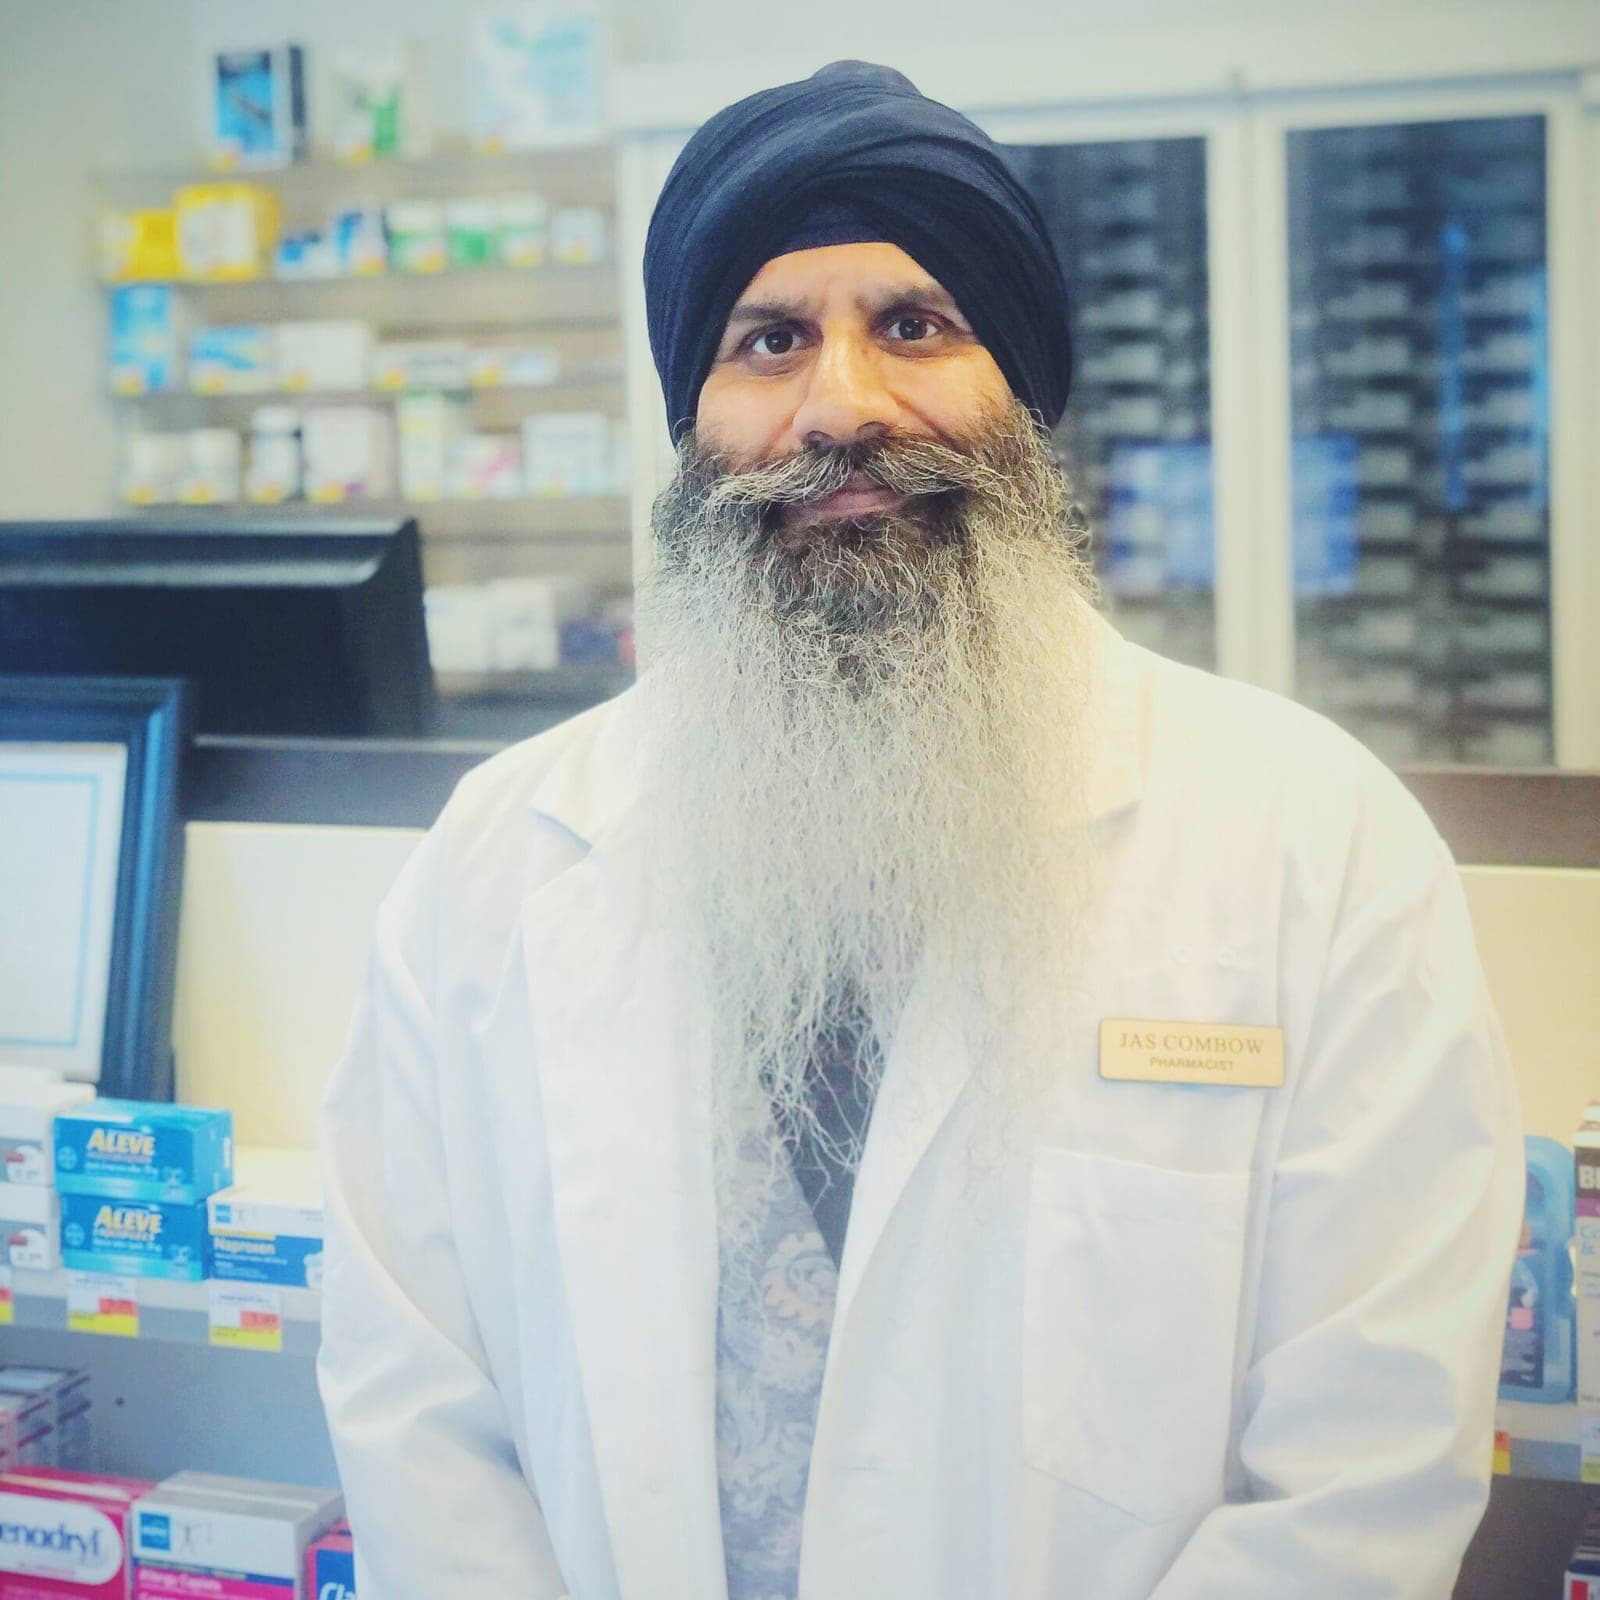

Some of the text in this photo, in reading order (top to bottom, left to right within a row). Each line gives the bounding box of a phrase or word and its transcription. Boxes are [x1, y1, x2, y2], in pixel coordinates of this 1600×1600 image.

[1119, 1032, 1264, 1054] JAS COMBOW
[1149, 1057, 1235, 1072] PHARMACIST
[87, 1127, 155, 1156] ALEVE
[93, 1205, 162, 1234] ALEVE
